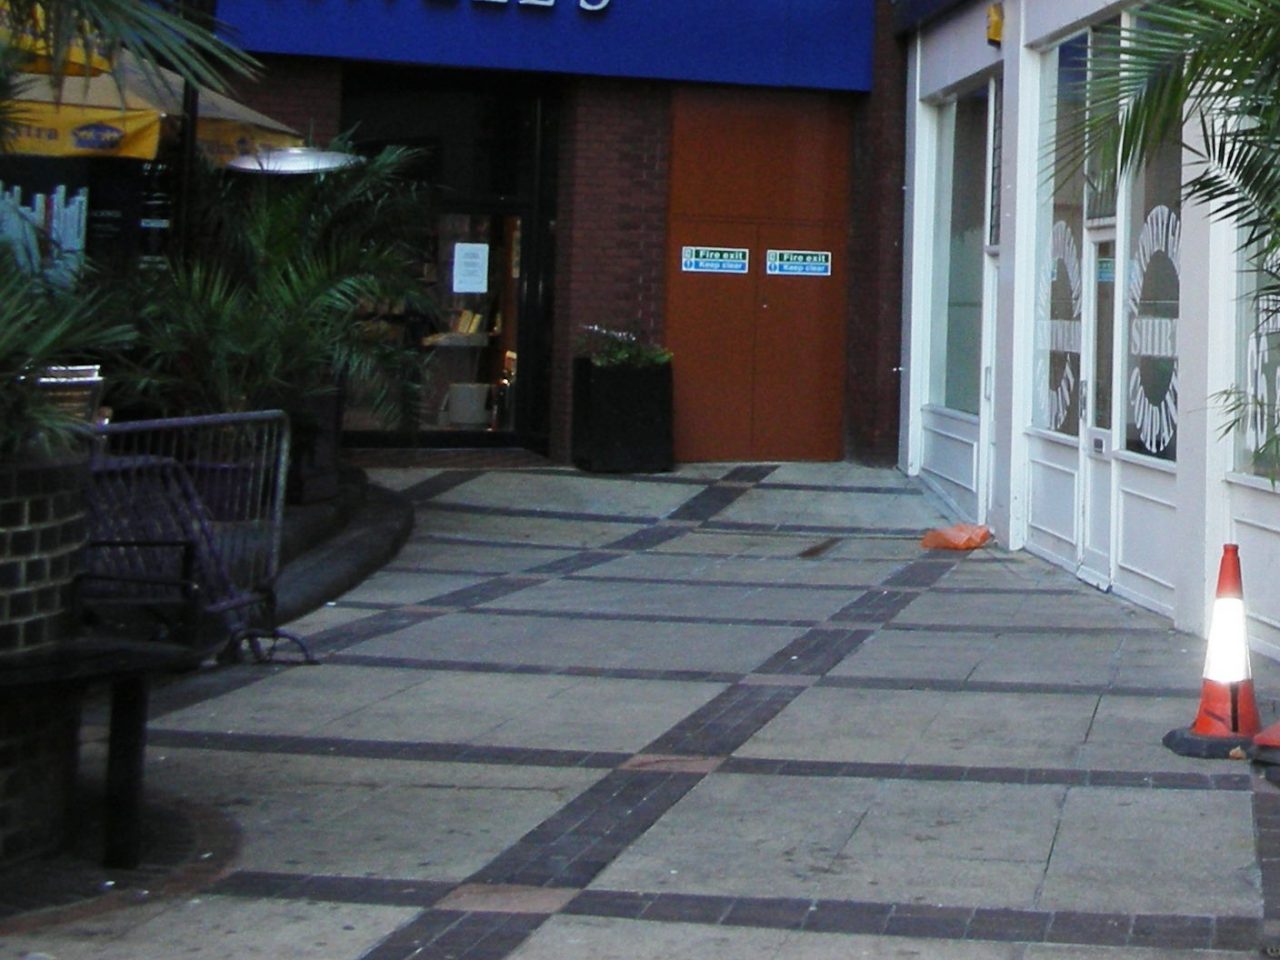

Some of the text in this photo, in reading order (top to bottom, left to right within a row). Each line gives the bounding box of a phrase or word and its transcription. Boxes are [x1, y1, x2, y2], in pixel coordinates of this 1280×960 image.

[699, 250, 743, 260] Fire exit
[783, 253, 805, 262] Fire
[699, 260, 743, 269] Keep clear
[783, 263, 825, 272] Keep clear
